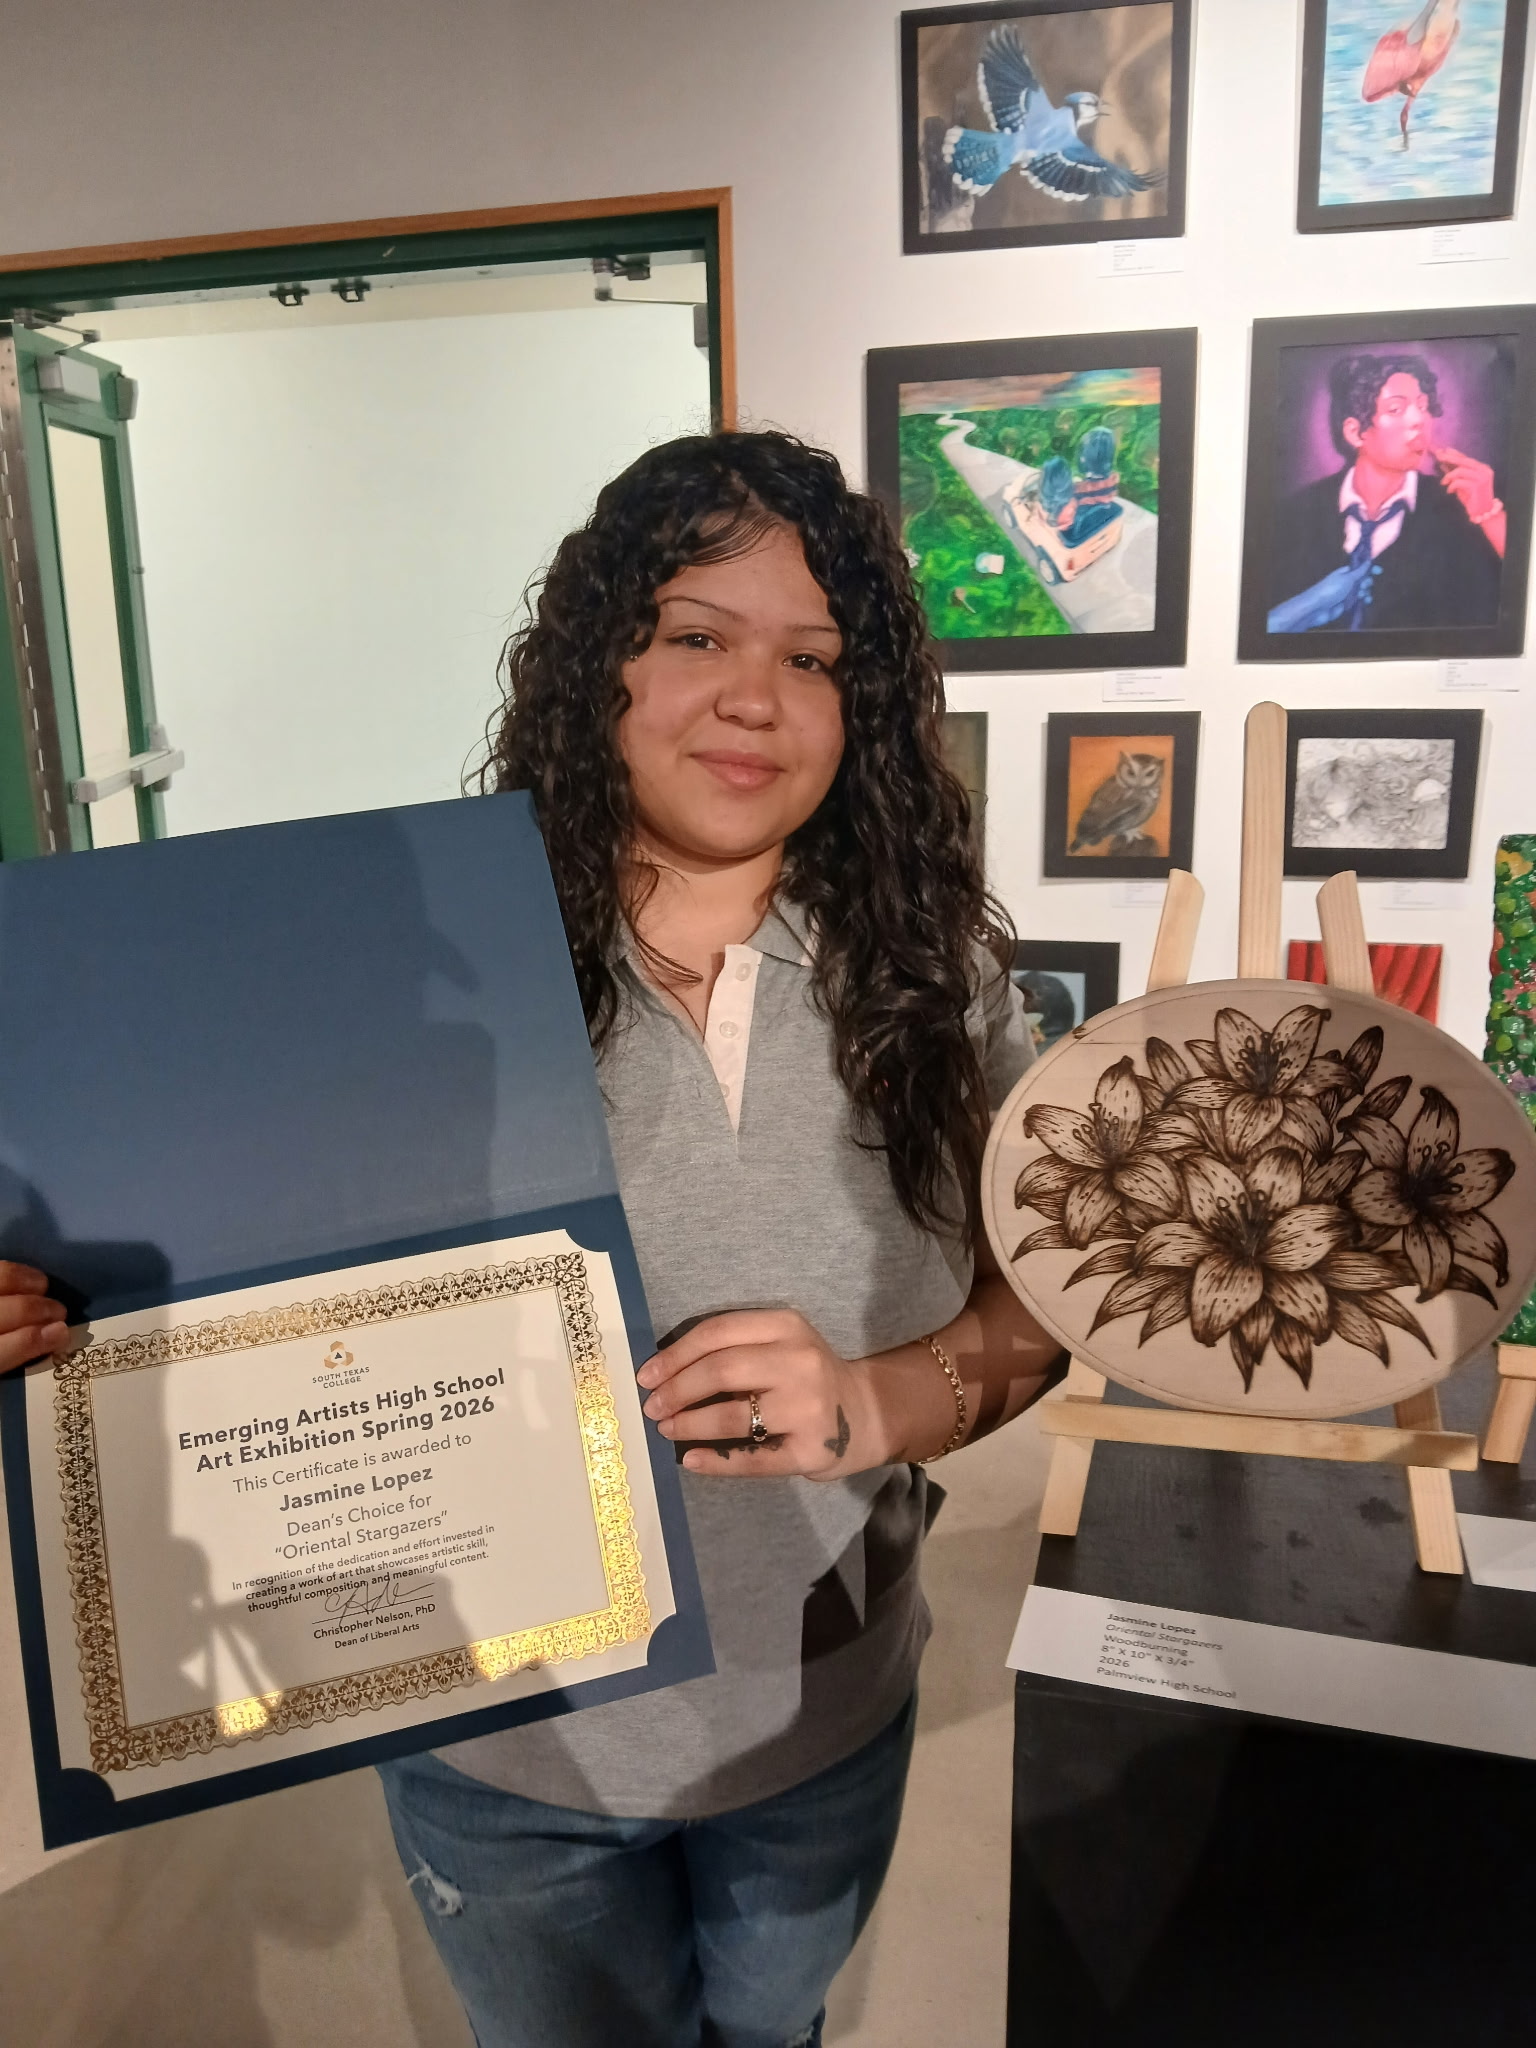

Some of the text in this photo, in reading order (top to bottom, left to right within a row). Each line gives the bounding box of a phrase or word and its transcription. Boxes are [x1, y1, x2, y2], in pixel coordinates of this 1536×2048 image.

[312, 1367, 370, 1384] SOUTH TEXAS
[323, 1376, 362, 1389] COLLEGE
[179, 1368, 505, 1450] Emerging Artists High School
[196, 1396, 494, 1472] Art Exhibition Spring 2026
[233, 1434, 471, 1493] This Certificate is awarded to
[280, 1466, 433, 1511] Jasmine Lopez
[348, 1501, 404, 1523] Choice
[409, 1495, 432, 1509] for
[232, 1525, 495, 1590] In recognition of the dedication and effort invested in
[246, 1583, 287, 1600] creating
[298, 1576, 324, 1588] work
[326, 1572, 336, 1582] of
[339, 1570, 353, 1579] art
[355, 1566, 375, 1576] that
[378, 1553, 429, 1571] showcases
[432, 1544, 465, 1558] artistic
[467, 1538, 488, 1551] skill,
[248, 1593, 302, 1612] thoughtful
[371, 1573, 390, 1585] and
[393, 1559, 448, 1580] meaningful
[450, 1552, 489, 1566] content.
[314, 1604, 436, 1639] Christopher Nelson, PhD
[335, 1623, 420, 1648] Dean of Liberal Arts
[1106, 1624, 1223, 1650] Oriental Stargazers
[1107, 1613, 1196, 1635] Jasmine Lopez
[1104, 1635, 1188, 1656] Woodburning
[1100, 1656, 1130, 1668] 2026
[1097, 1667, 1236, 1698] Palmview High School
